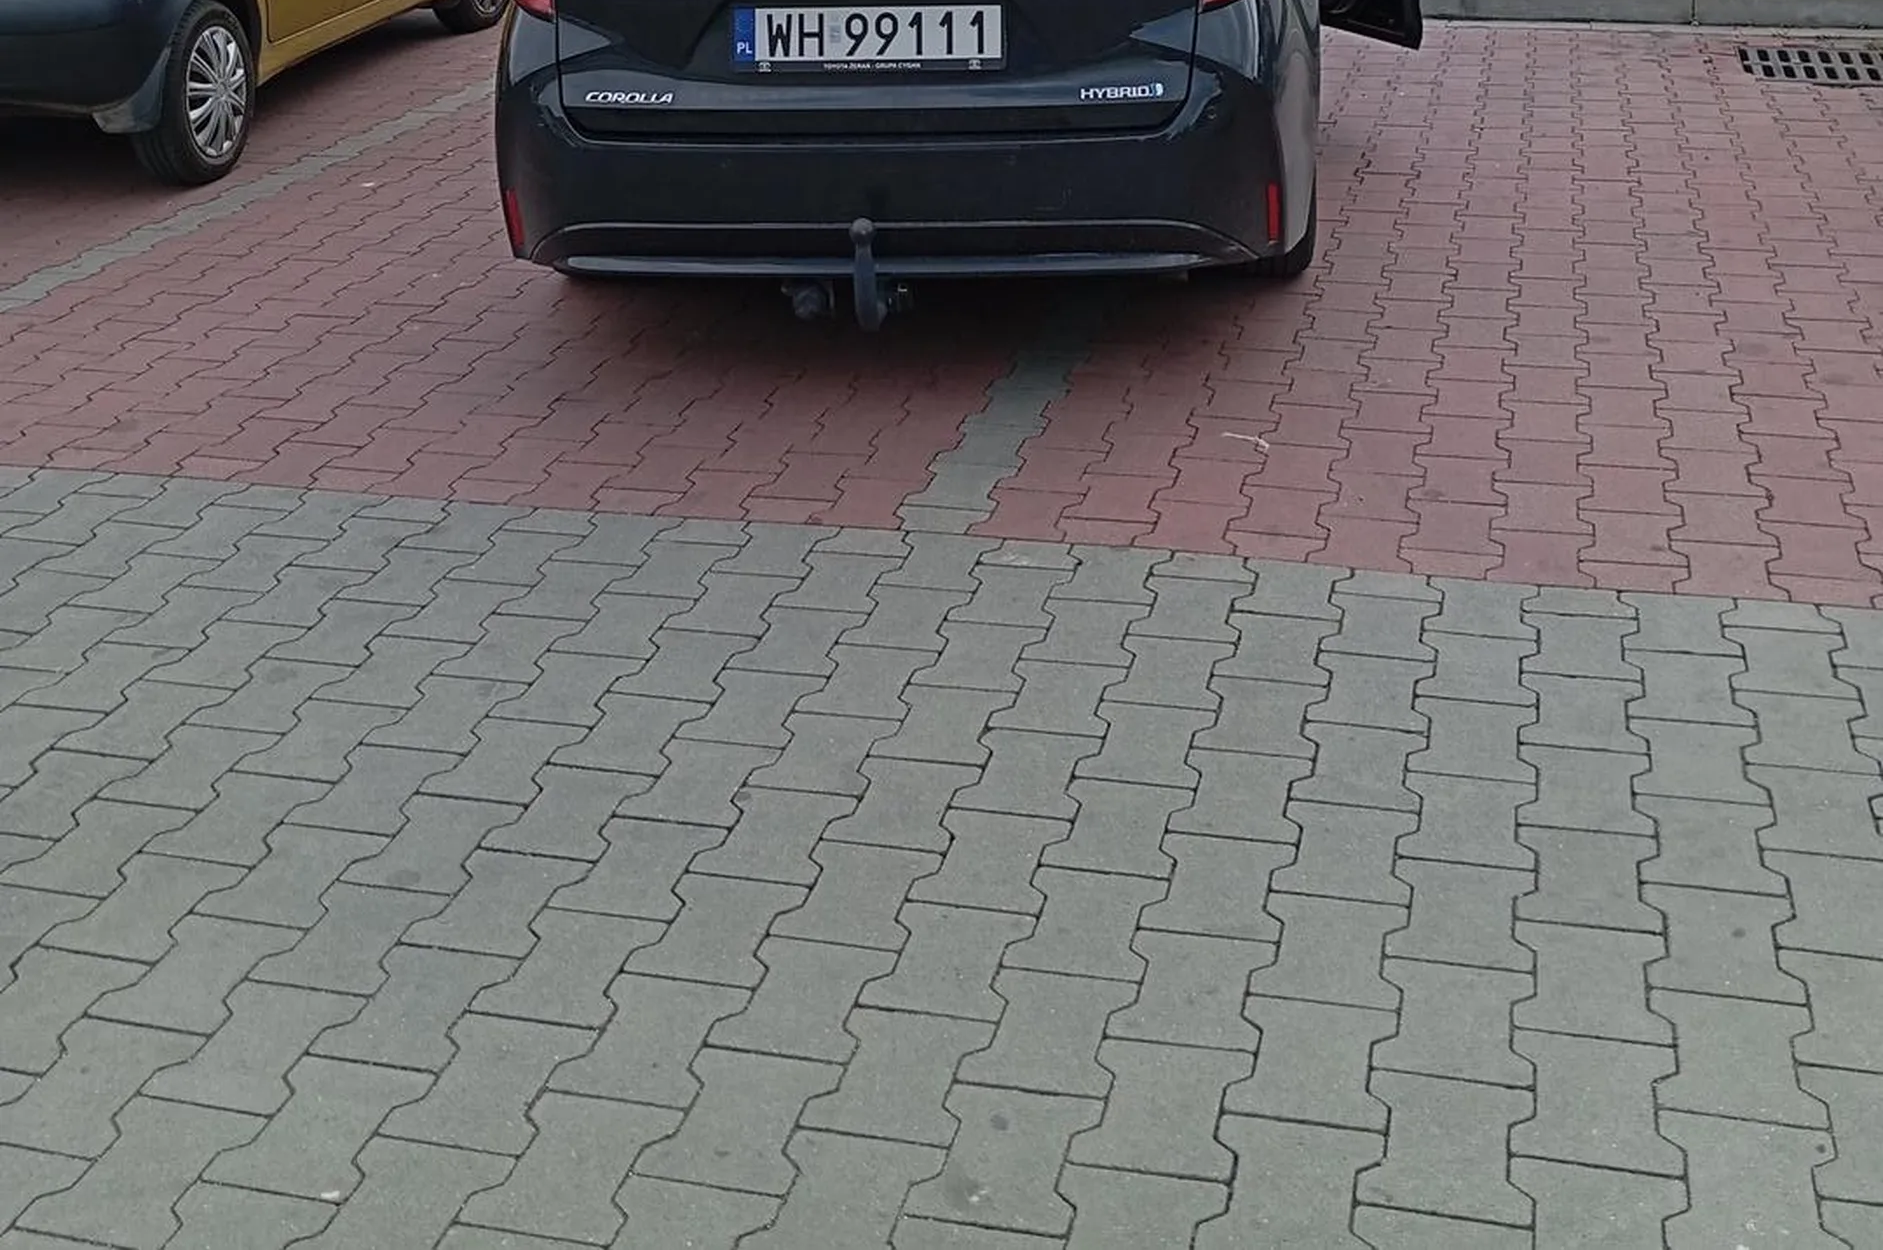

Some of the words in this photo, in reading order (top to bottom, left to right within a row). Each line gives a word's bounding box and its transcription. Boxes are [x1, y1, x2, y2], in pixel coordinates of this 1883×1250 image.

[766, 12, 824, 57] WH
[844, 10, 985, 57] 99111
[736, 42, 753, 55] PL
[585, 91, 673, 104] COROLLA
[1080, 86, 1150, 100] HYBRID
